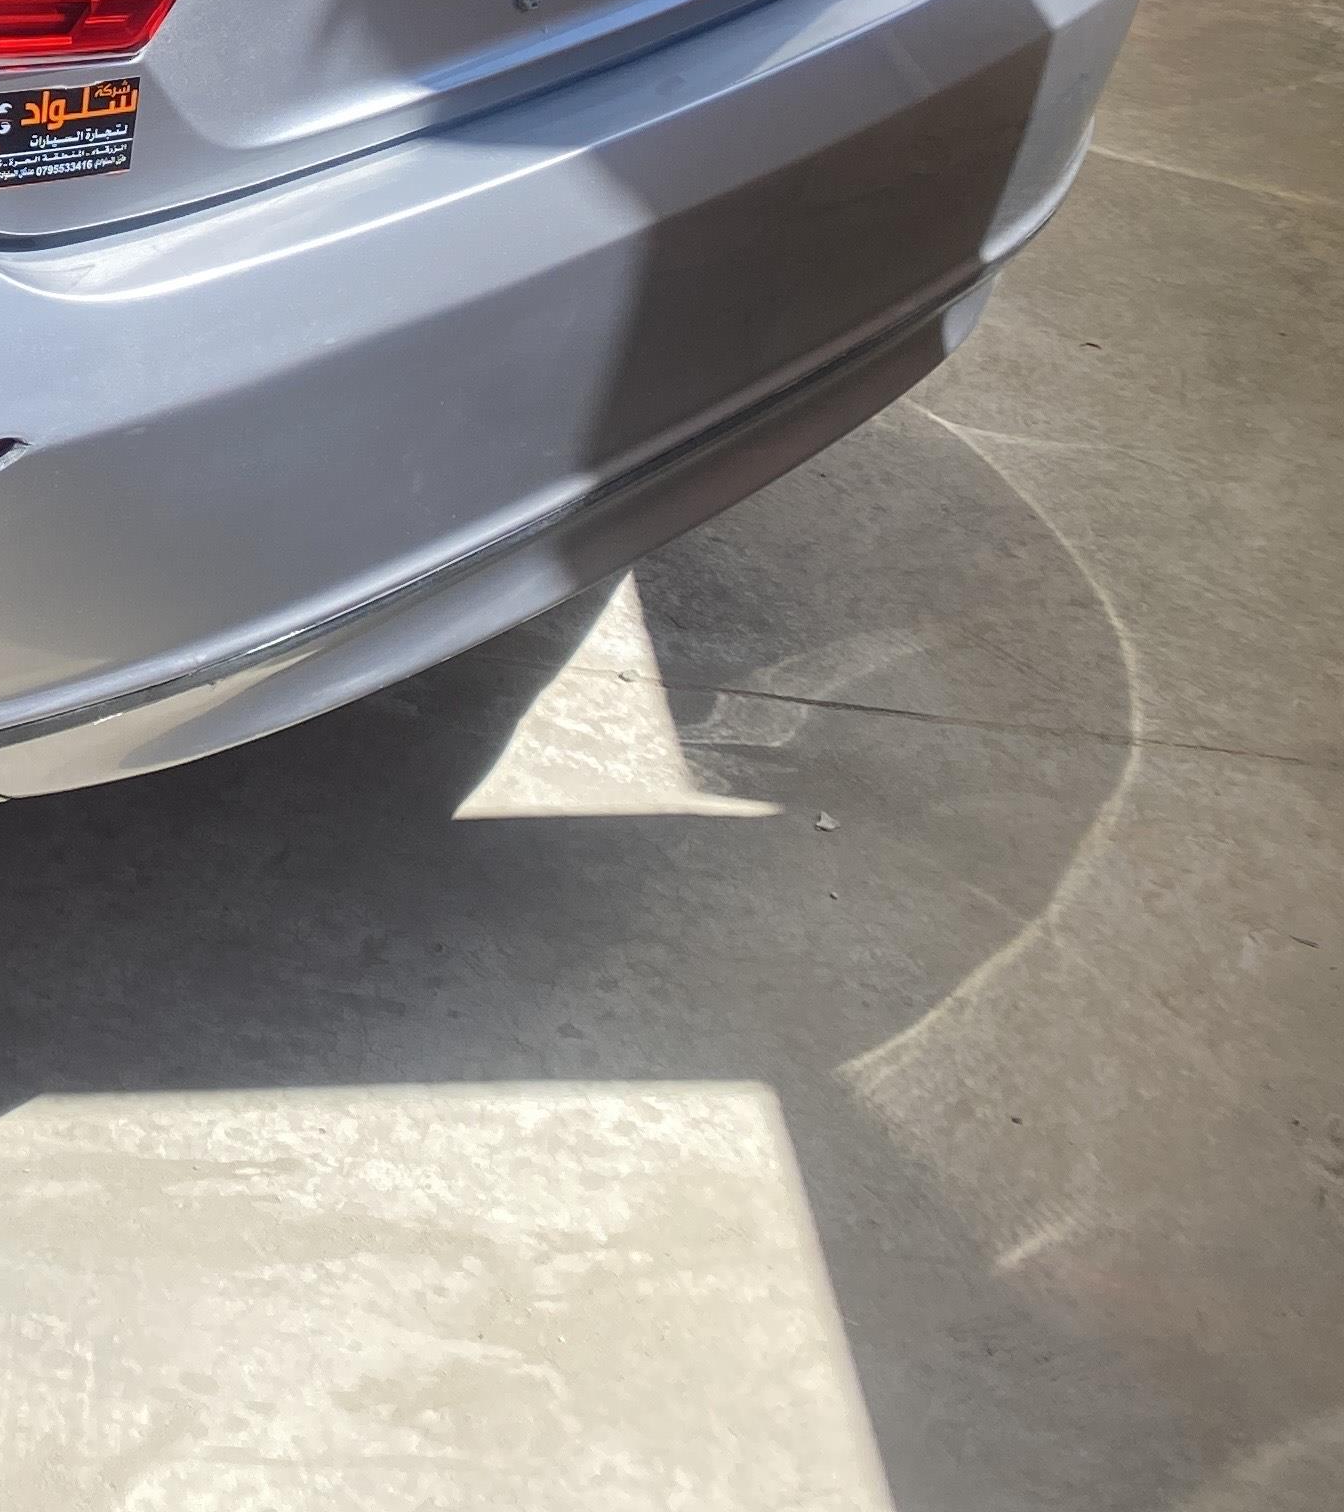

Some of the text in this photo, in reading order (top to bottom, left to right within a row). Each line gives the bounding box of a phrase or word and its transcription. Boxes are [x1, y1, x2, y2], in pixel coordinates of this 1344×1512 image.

[94, 80, 131, 97] شركة
[21, 86, 138, 130] سلواد
[30, 124, 128, 148] لتجارة السيارات
[36, 159, 93, 177] 0795533416
